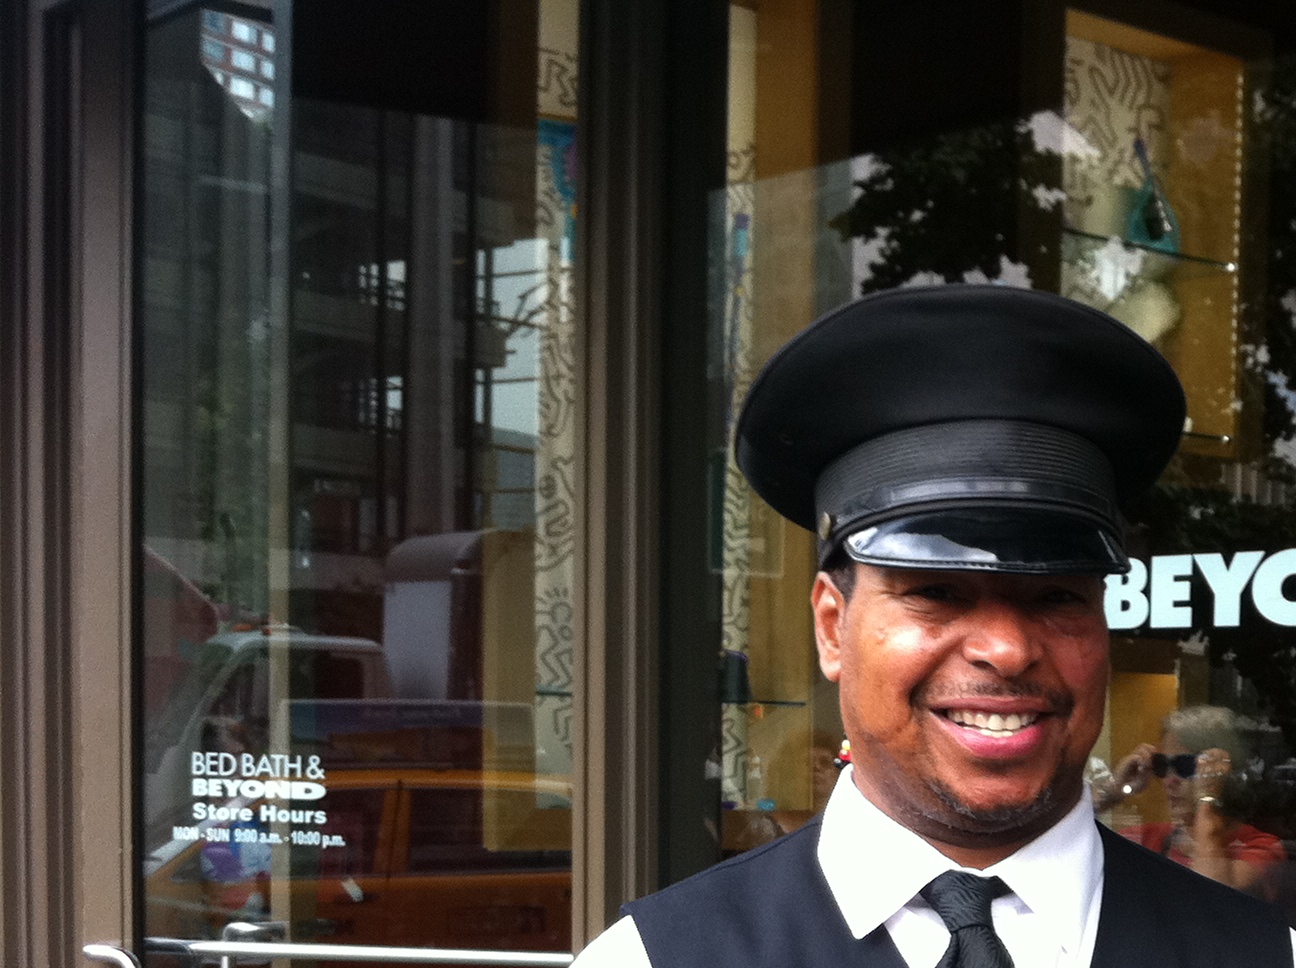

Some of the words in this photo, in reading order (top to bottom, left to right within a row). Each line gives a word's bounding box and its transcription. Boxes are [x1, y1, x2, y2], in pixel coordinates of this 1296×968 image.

[191, 751, 237, 777] BED
[241, 753, 302, 779] BATH
[305, 754, 326, 780] &
[192, 778, 327, 800] BEYOND
[192, 802, 254, 822] Store
[260, 804, 327, 824] Hours
[234, 828, 258, 843] 9:00
[291, 830, 321, 846] 10:00
